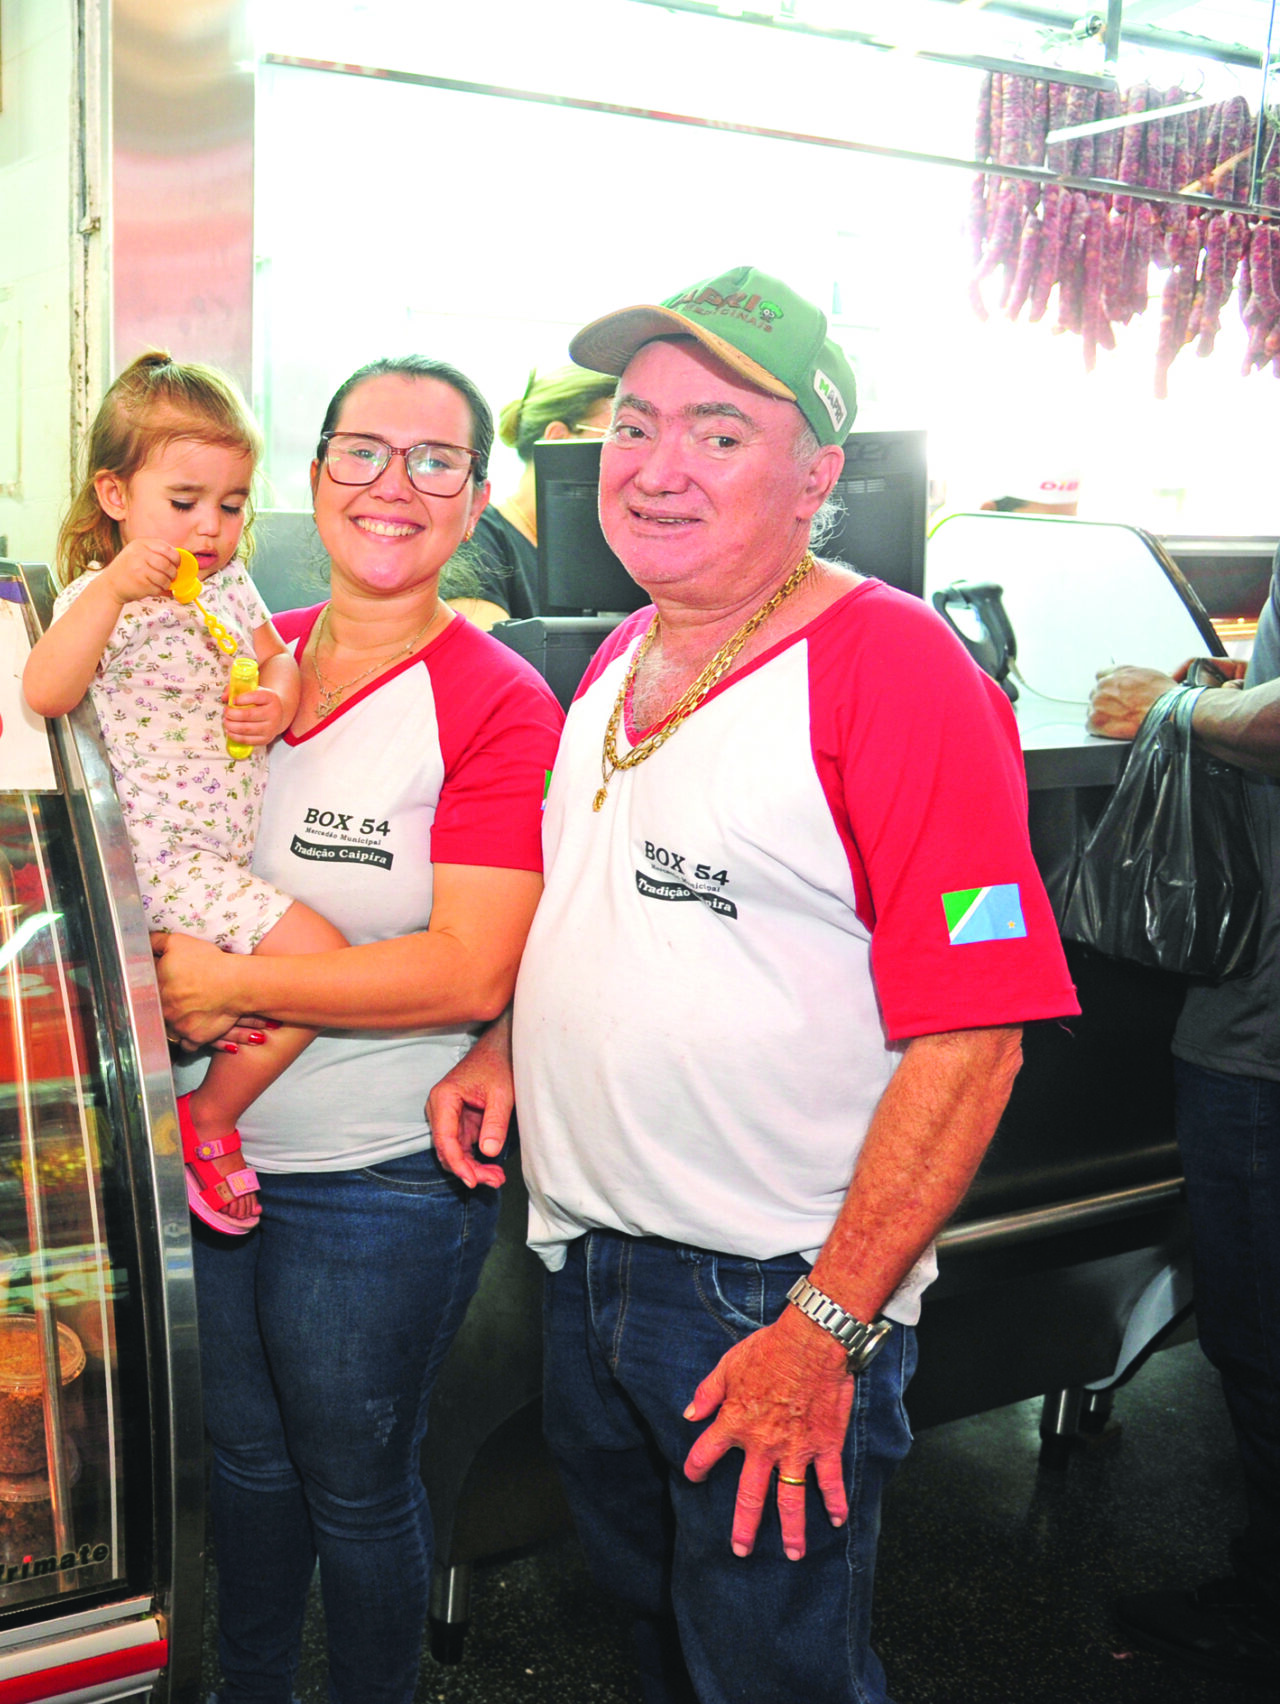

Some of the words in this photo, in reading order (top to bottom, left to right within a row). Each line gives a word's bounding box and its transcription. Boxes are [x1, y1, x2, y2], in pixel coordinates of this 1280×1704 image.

[303, 807, 354, 831] BOX
[359, 818, 391, 837] 54
[305, 826, 338, 839] Mercadão
[340, 833, 382, 846] Municipal
[293, 841, 336, 859] Tradição
[339, 849, 387, 864] Caipira
[644, 840, 686, 875] BOX
[694, 863, 730, 886] 54
[638, 877, 691, 899] Tradição
